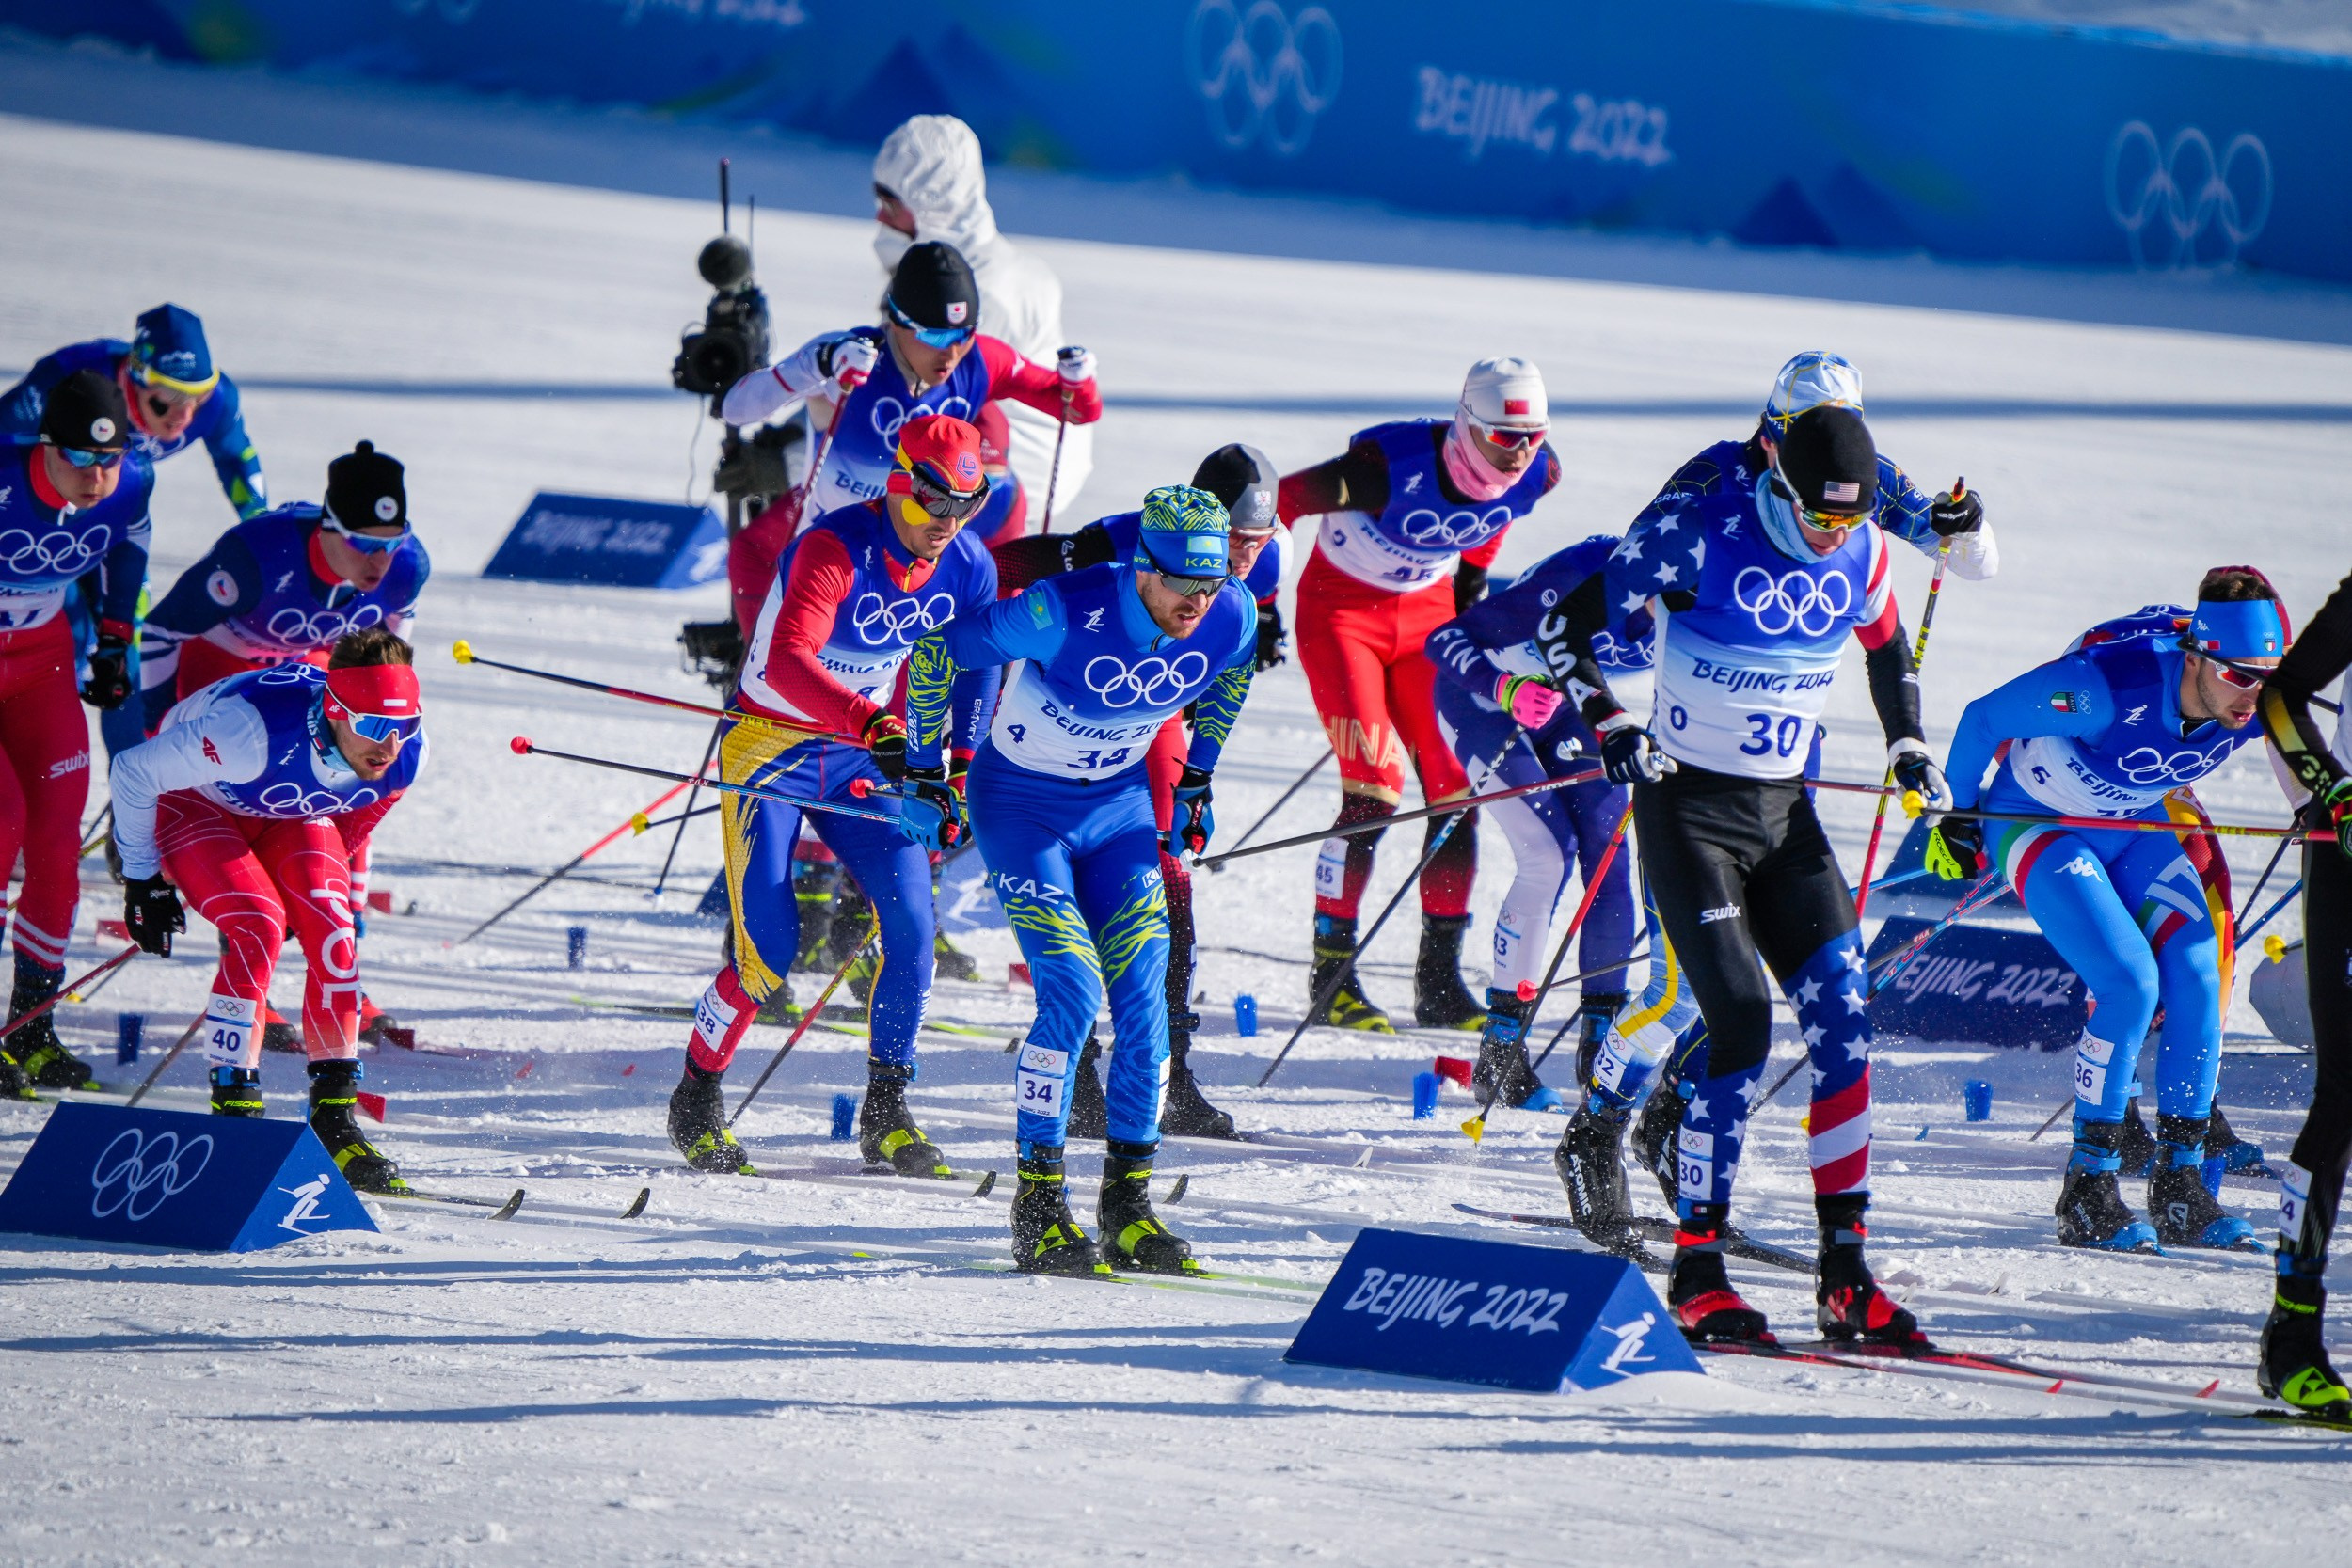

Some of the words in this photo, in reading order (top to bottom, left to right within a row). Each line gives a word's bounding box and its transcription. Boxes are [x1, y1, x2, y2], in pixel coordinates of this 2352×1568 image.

[1415, 66, 1558, 160] BEIJING
[1567, 91, 1673, 166] 2022
[1185, 558, 1223, 569] KAZ
[1433, 628, 1482, 675] FIN
[1538, 613, 1598, 715] USA
[1692, 657, 1790, 693] BEIJING
[1041, 699, 1128, 741] BEIJING
[1739, 712, 1802, 758] 30
[202, 736, 223, 766] 4F
[1066, 747, 1133, 769] 34
[1319, 712, 1404, 777] HINA
[998, 873, 1065, 905] KAZ
[1700, 902, 1741, 924] swix
[310, 878, 362, 1012] POL
[1986, 964, 2077, 1008] 2022
[698, 1005, 715, 1035] 38
[212, 1029, 241, 1052] 40
[1024, 1079, 1053, 1103] 34
[2076, 1062, 2094, 1089] 36
[224, 1100, 263, 1109] FISCHE
[318, 1097, 358, 1105] FISCHE
[1017, 1169, 1063, 1182] FISCHER
[1569, 1153, 1593, 1217] ATOMIC
[1680, 1161, 1703, 1187] 30
[1343, 1267, 1480, 1332] BEIJING
[1468, 1284, 1570, 1336] 2022
